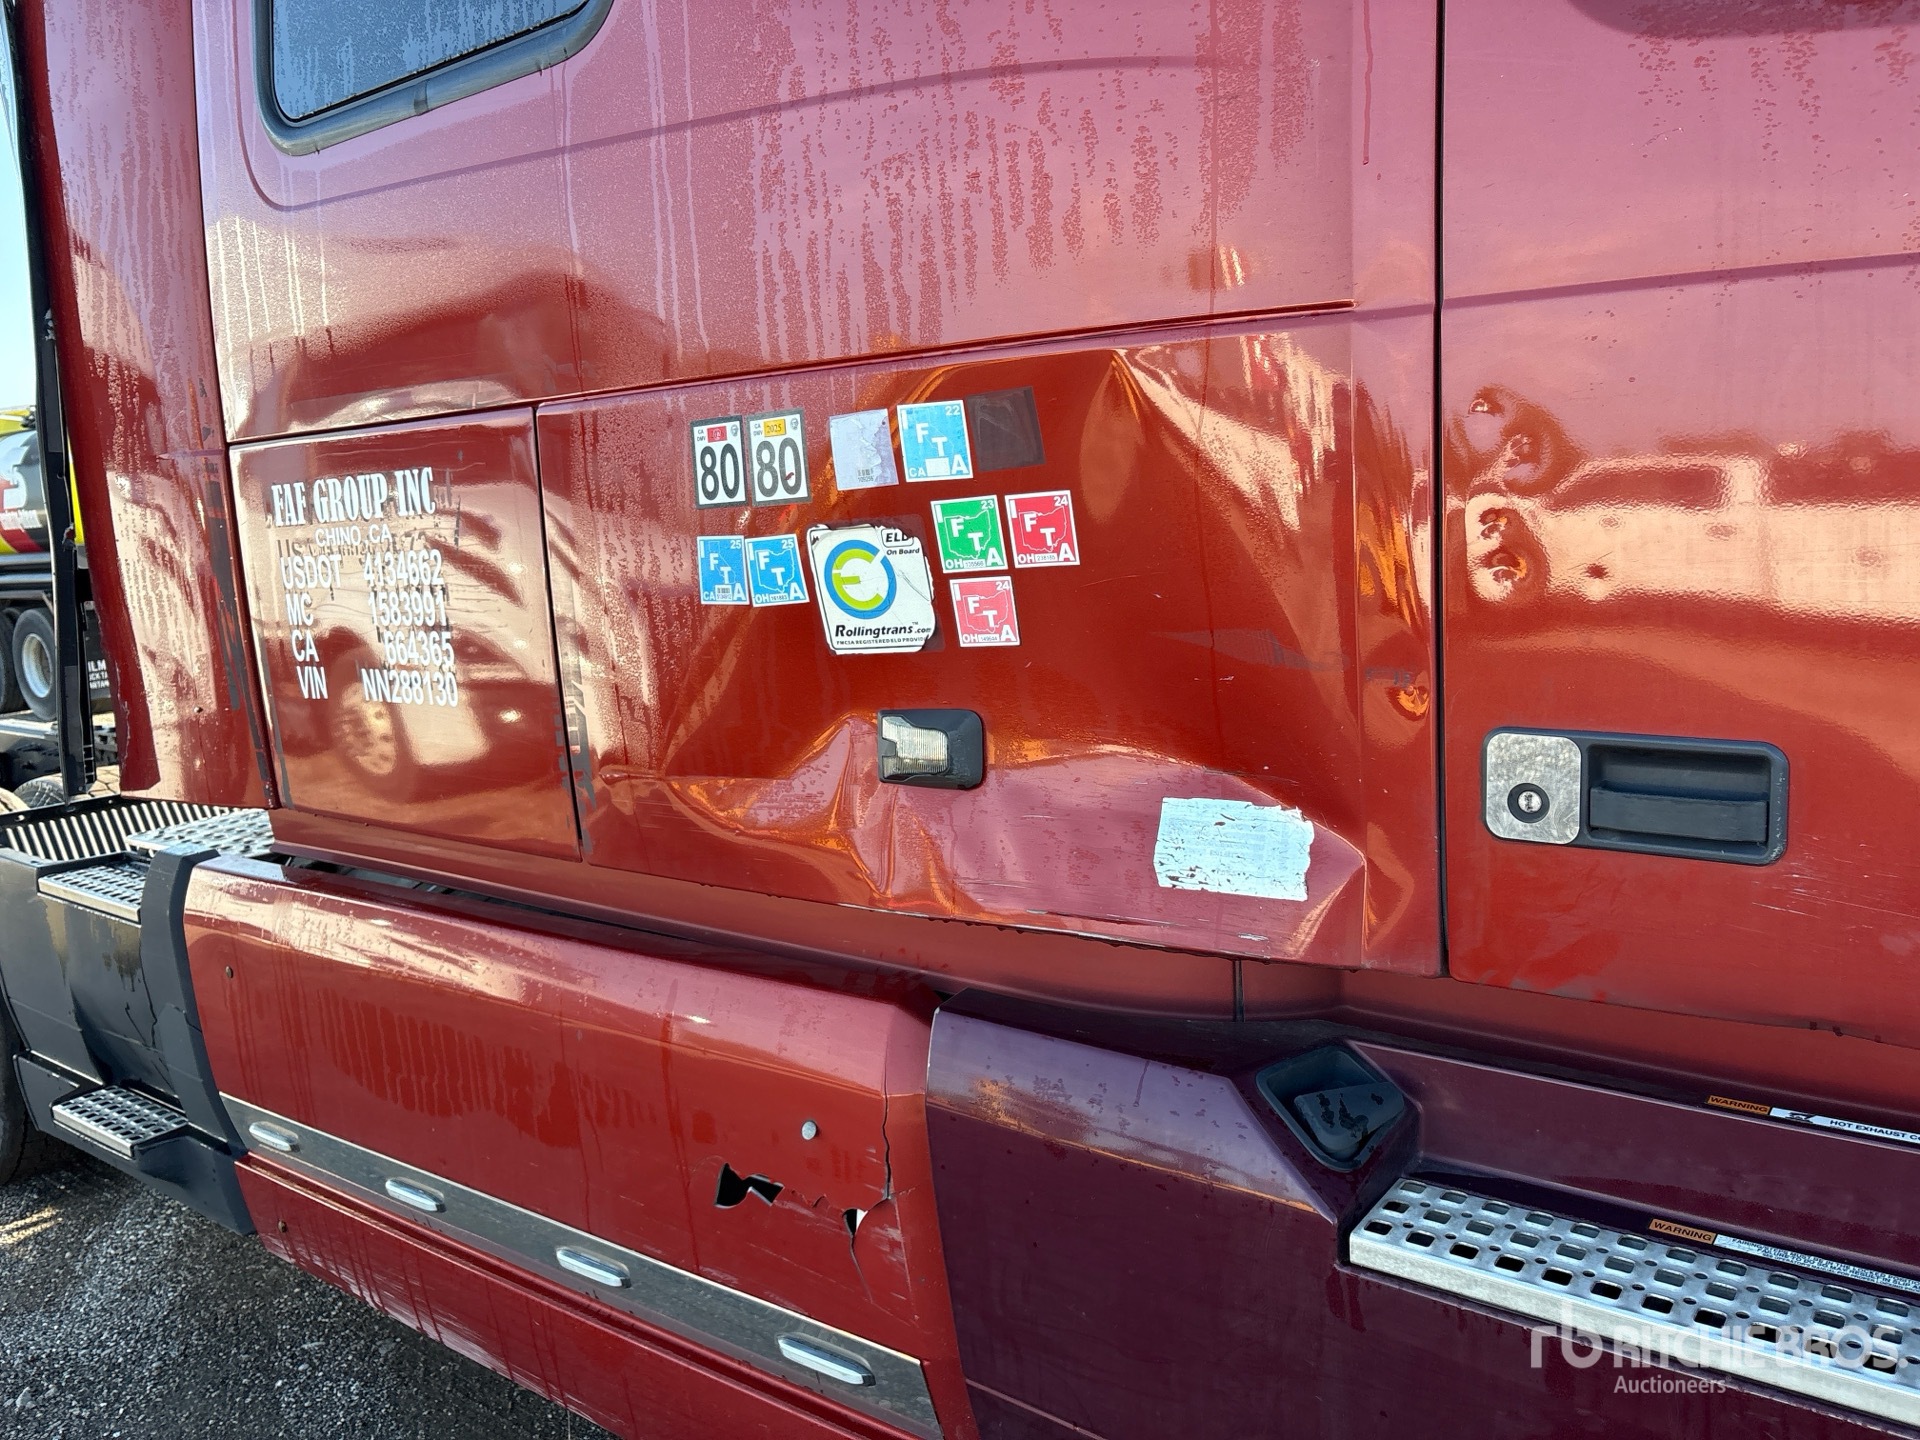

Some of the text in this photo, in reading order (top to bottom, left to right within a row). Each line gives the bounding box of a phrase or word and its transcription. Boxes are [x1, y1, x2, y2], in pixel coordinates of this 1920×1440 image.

[945, 405, 960, 416] 22
[766, 423, 782, 433] 2025
[700, 443, 740, 500] 80
[756, 437, 802, 497] 80
[909, 467, 926, 478] CA
[271, 467, 436, 527] FAF GROUP INC
[1053, 496, 1068, 507] 24
[981, 500, 995, 509] 23
[730, 540, 741, 549] 25
[781, 540, 794, 549] 25
[1018, 553, 1035, 563] OH
[280, 549, 444, 589] USDOT 4134662
[945, 559, 963, 569] OH
[996, 581, 1010, 590] 24
[703, 591, 715, 600] CA
[755, 594, 769, 603] OH
[285, 590, 447, 627] MC 1583991
[963, 633, 978, 643] OH
[291, 629, 455, 668] CA 664365
[296, 665, 458, 707] VIN NN288130
[1710, 1096, 1768, 1113] WARNING
[1830, 1120, 1853, 1128] HOT
[1856, 1125, 1907, 1138] EXHAUST
[1652, 1220, 1712, 1242] WARNING
